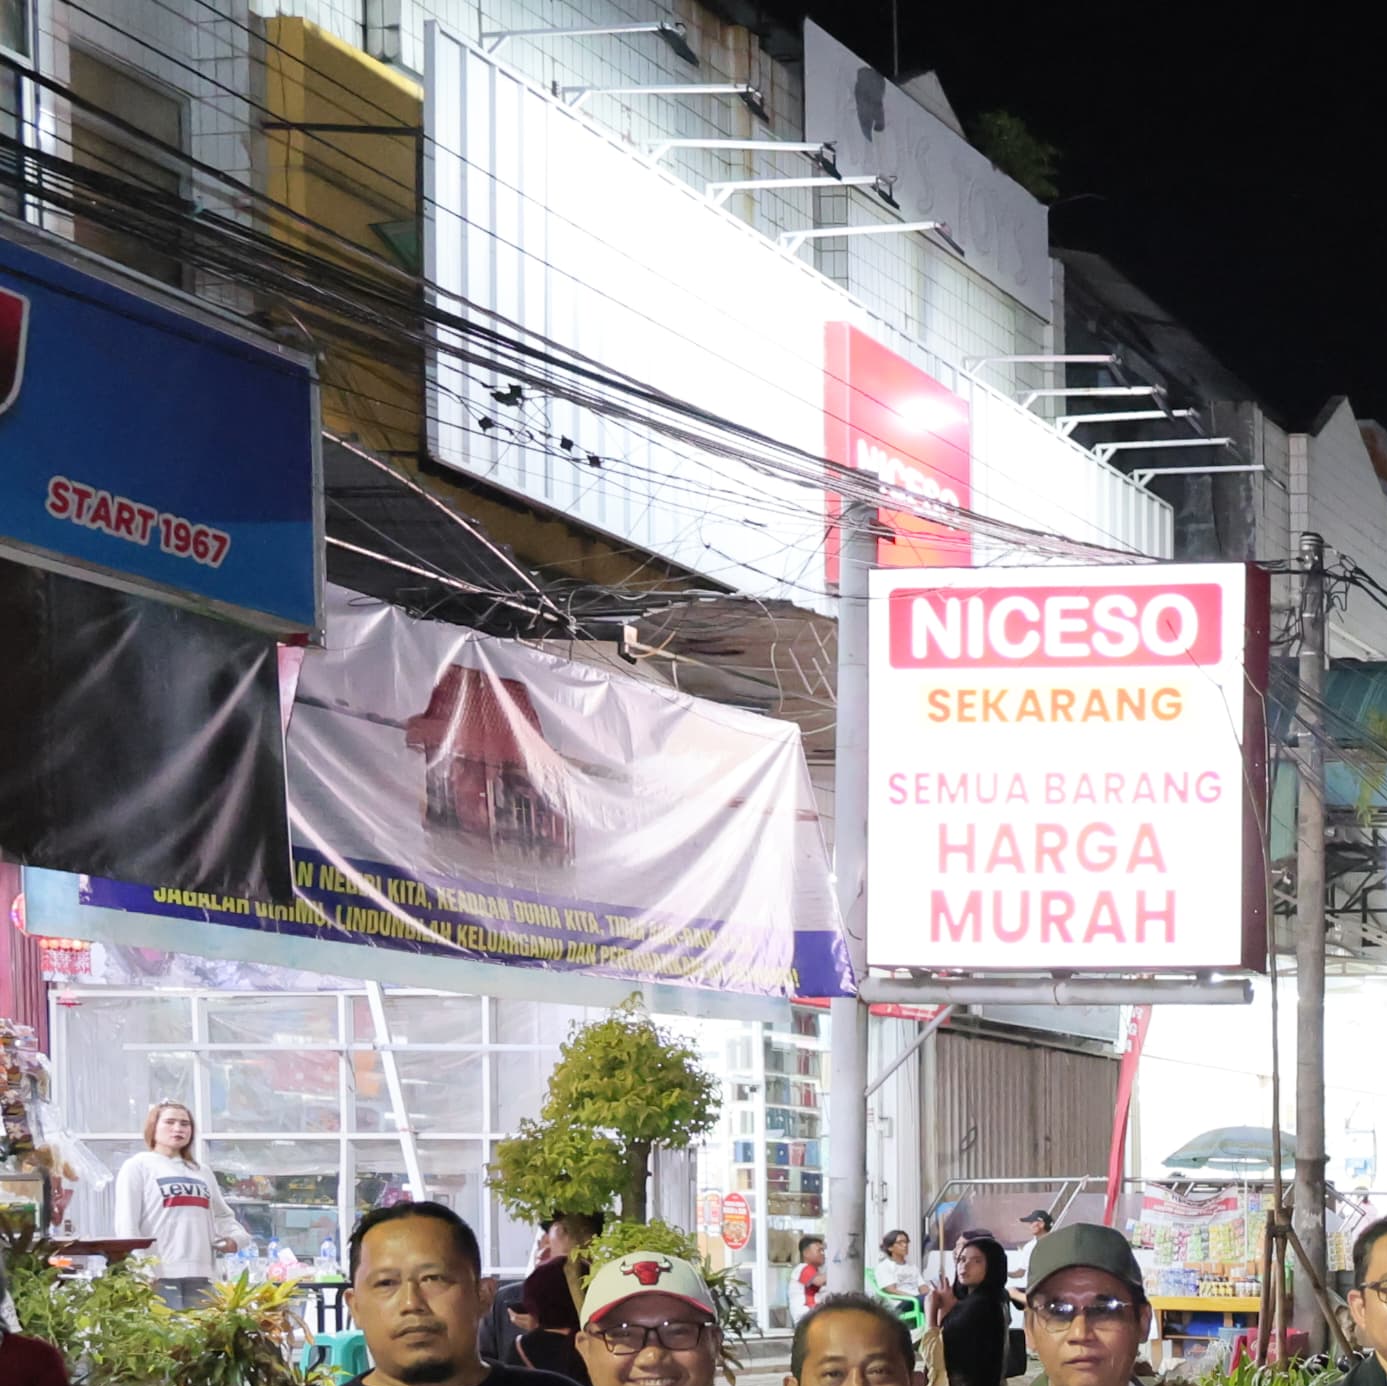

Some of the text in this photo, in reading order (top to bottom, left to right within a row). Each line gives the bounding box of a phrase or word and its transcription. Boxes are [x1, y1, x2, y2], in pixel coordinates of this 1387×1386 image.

[47, 477, 231, 568] START 1967
[911, 593, 1200, 660] NICESO
[927, 687, 1184, 723] SEKARANG
[888, 770, 1223, 806] SEMUA BARANG
[937, 822, 1167, 875] HARGA
[929, 889, 1177, 944] MURAH
